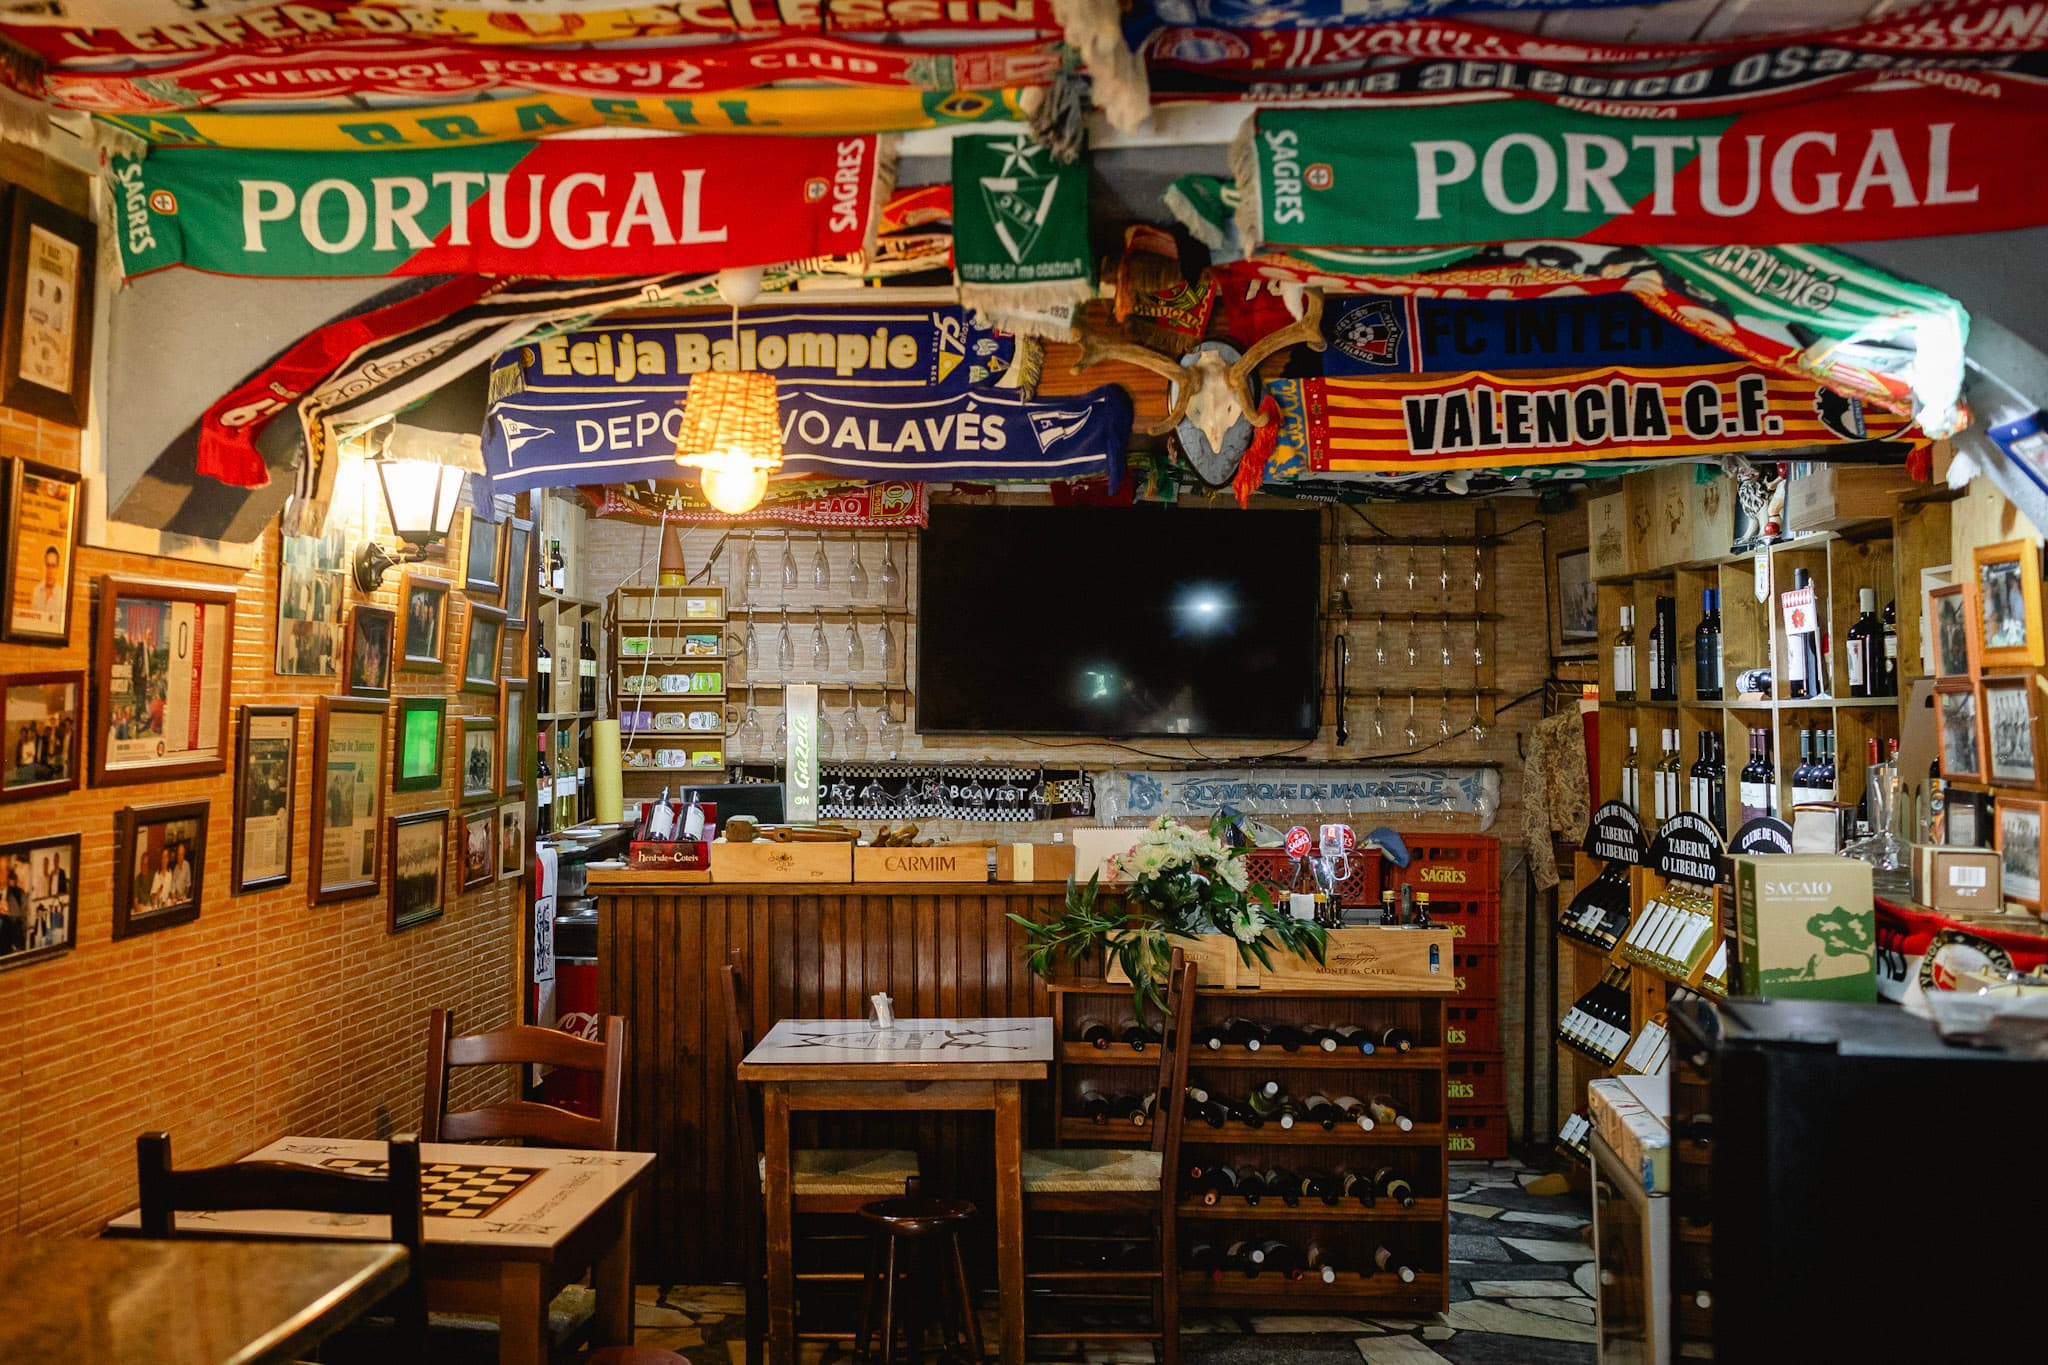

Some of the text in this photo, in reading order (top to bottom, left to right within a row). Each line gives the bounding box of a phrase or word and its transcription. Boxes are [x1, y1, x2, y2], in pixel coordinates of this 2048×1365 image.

[63, 3, 333, 50] L'ENFER
[209, 60, 451, 90] LIVERPOOL
[750, 54, 877, 74] CLUB
[829, 138, 865, 233] SAGRES
[1264, 129, 1303, 225] SAGRES
[1410, 122, 1979, 221] PORTUGAL
[118, 163, 156, 254] SAGRES
[239, 168, 728, 255] PORTUGAL
[1714, 244, 1843, 311] mpié
[539, 332, 666, 383] Ecija
[674, 327, 918, 377] Balompie
[832, 400, 1008, 453] ALAVÉS
[1402, 373, 1785, 455] VALENCIA C.F.
[884, 485, 906, 511] 30
[791, 713, 810, 789] Gazela
[817, 784, 1039, 802] ORÇA BOAVISTA
[1183, 781, 1298, 801] OLYMPIQUE
[1300, 782, 1328, 801] DE
[1594, 805, 1610, 825] CLUBE
[1611, 805, 1619, 816] DE
[1600, 825, 1634, 844] TABERNA
[1661, 816, 1718, 849] CLUBE DE VINHOS
[1742, 827, 1792, 854] CLUBE DE VINHO
[885, 855, 956, 872] CARMIM
[1595, 842, 1639, 864] O LIBERATO
[1668, 838, 1711, 861] TABERNA
[1420, 867, 1467, 883] SAGRES
[1661, 856, 1716, 882] O LIBERATO
[1764, 881, 1833, 896] SACAIO
[1316, 967, 1348, 975] MONTE
[1364, 967, 1396, 975] CAPELA
